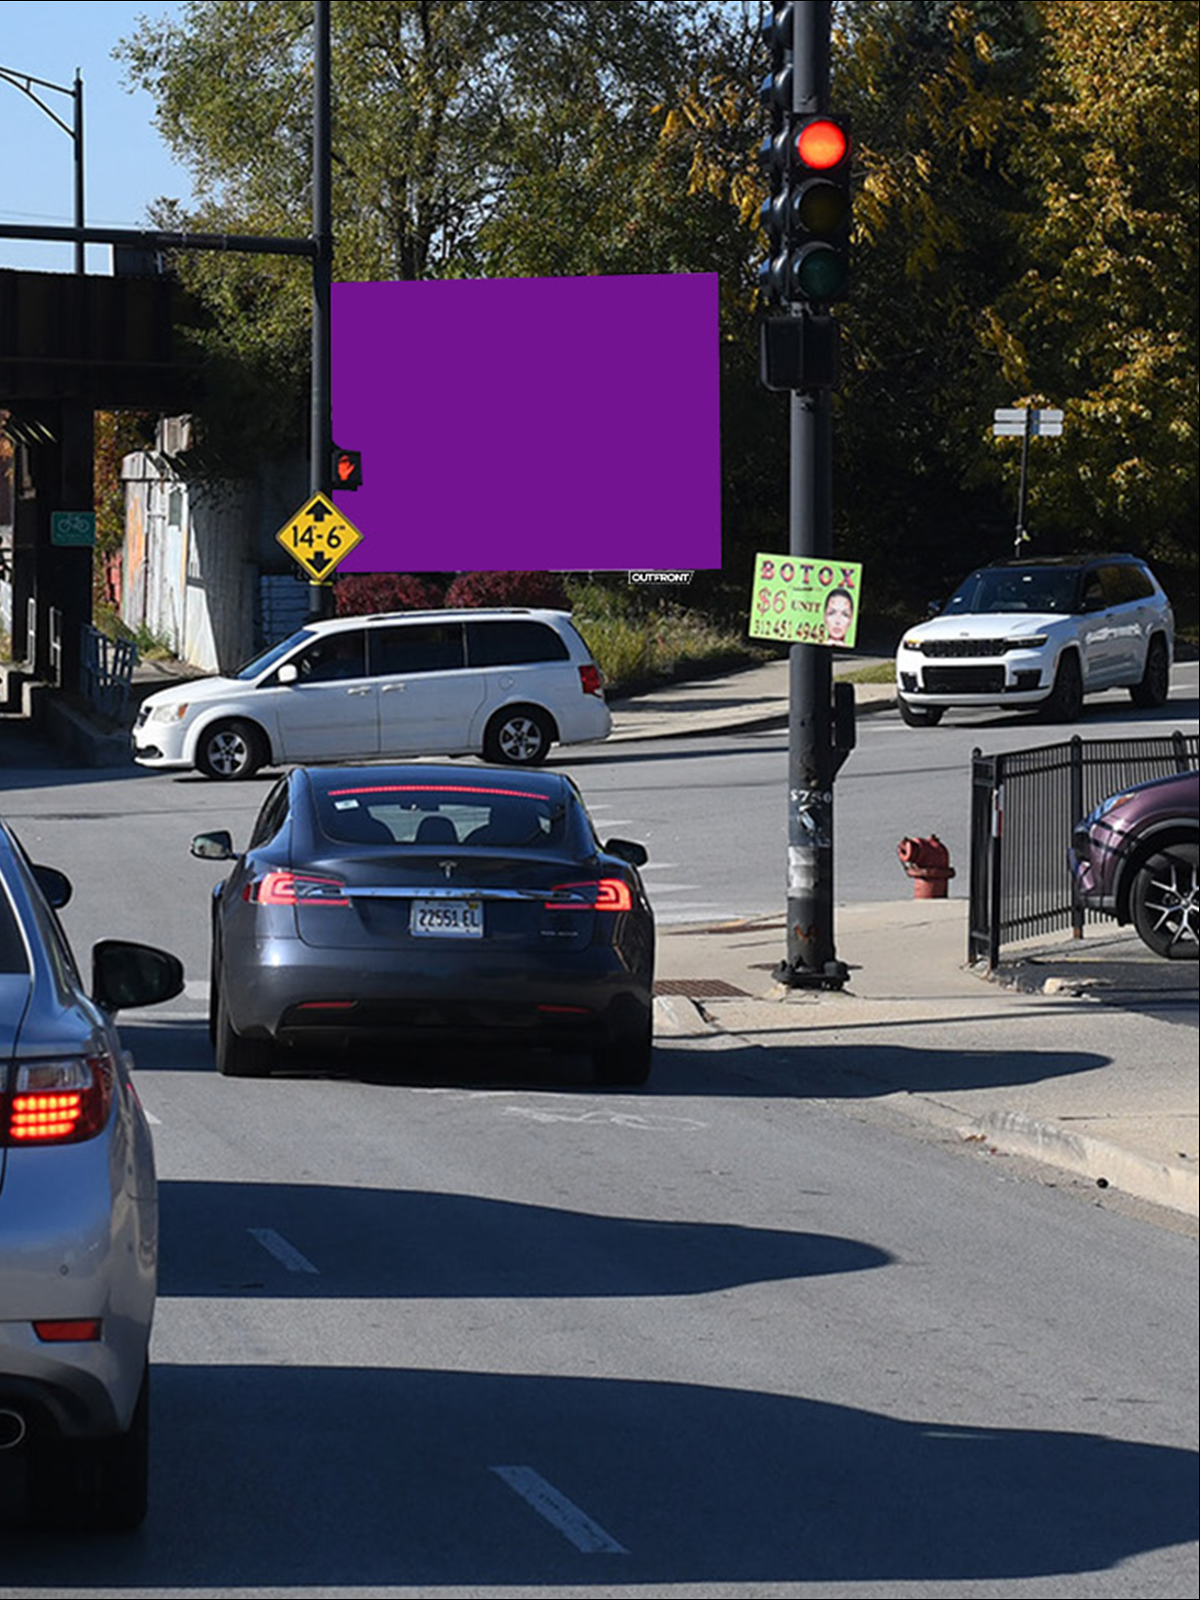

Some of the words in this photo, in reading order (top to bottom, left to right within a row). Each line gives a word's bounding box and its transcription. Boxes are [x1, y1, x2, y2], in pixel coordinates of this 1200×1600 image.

[631, 573, 690, 582] OUTFRONT
[760, 559, 856, 589] BOTOX
[756, 586, 788, 616] $6
[791, 600, 821, 613] UNIT
[753, 619, 772, 636] 312
[419, 909, 459, 928] 22551
[462, 909, 480, 928] EL
